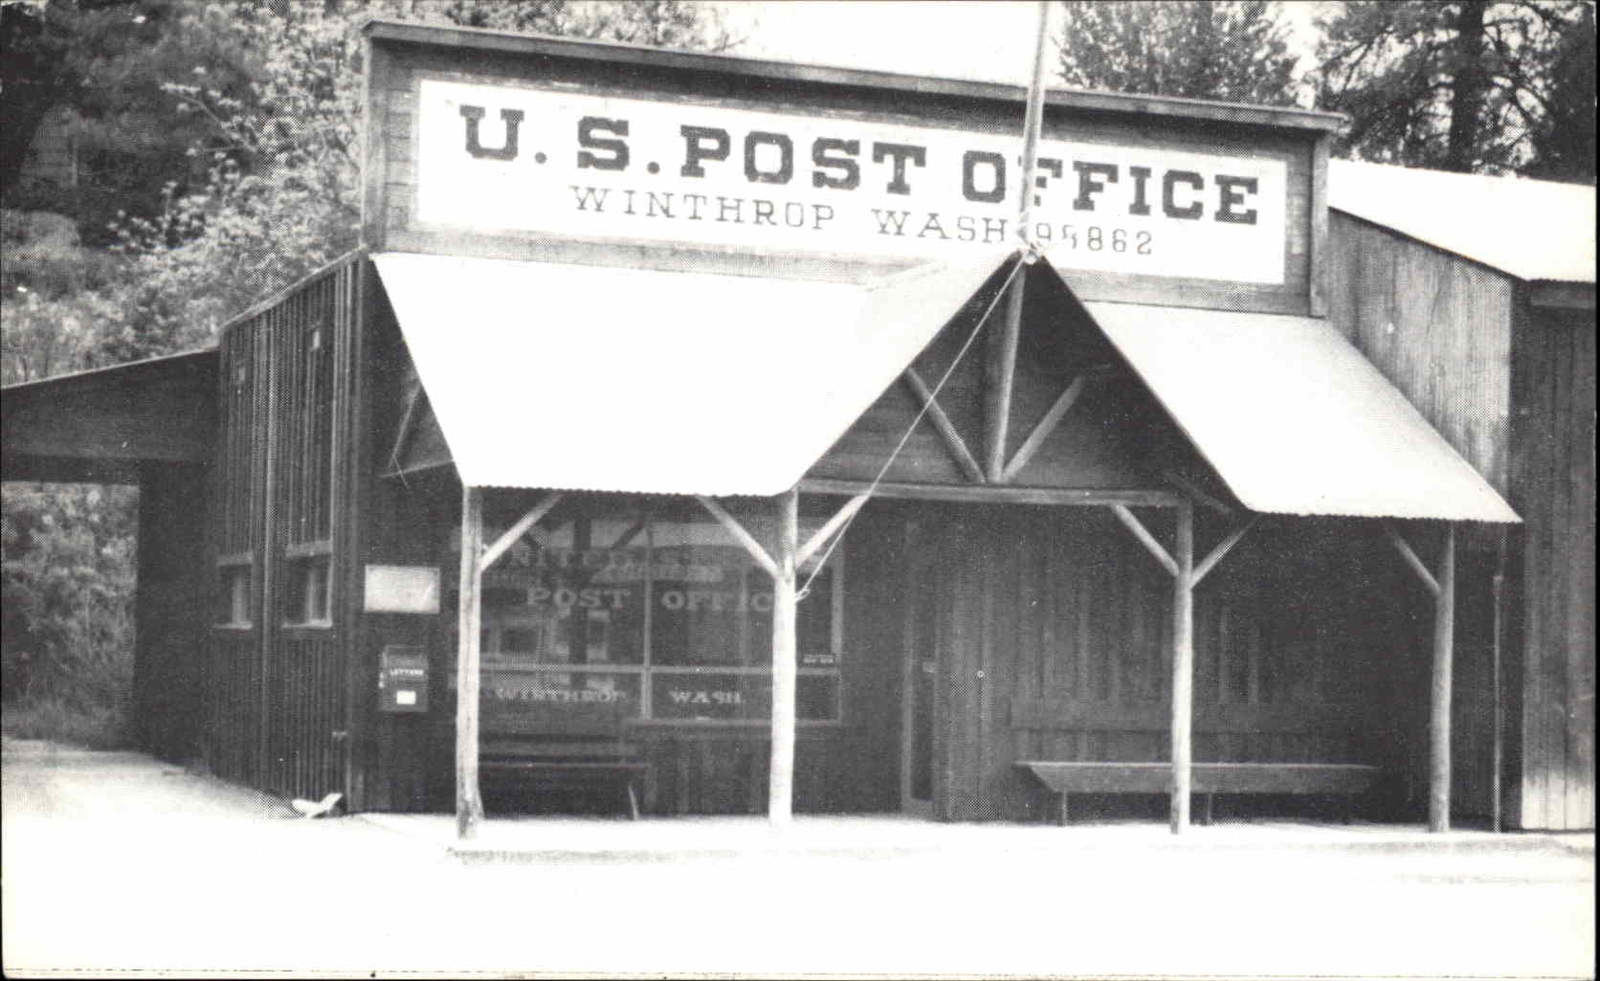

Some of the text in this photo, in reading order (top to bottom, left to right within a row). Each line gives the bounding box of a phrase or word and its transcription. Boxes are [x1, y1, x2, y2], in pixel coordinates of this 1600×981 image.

[680, 124, 927, 197] POST
[961, 149, 1259, 225] OFFICE
[569, 184, 836, 229] WINTHROP
[504, 548, 632, 570] NITED
[525, 586, 777, 613] POST OFFIC
[494, 686, 627, 703] WINTHROP
